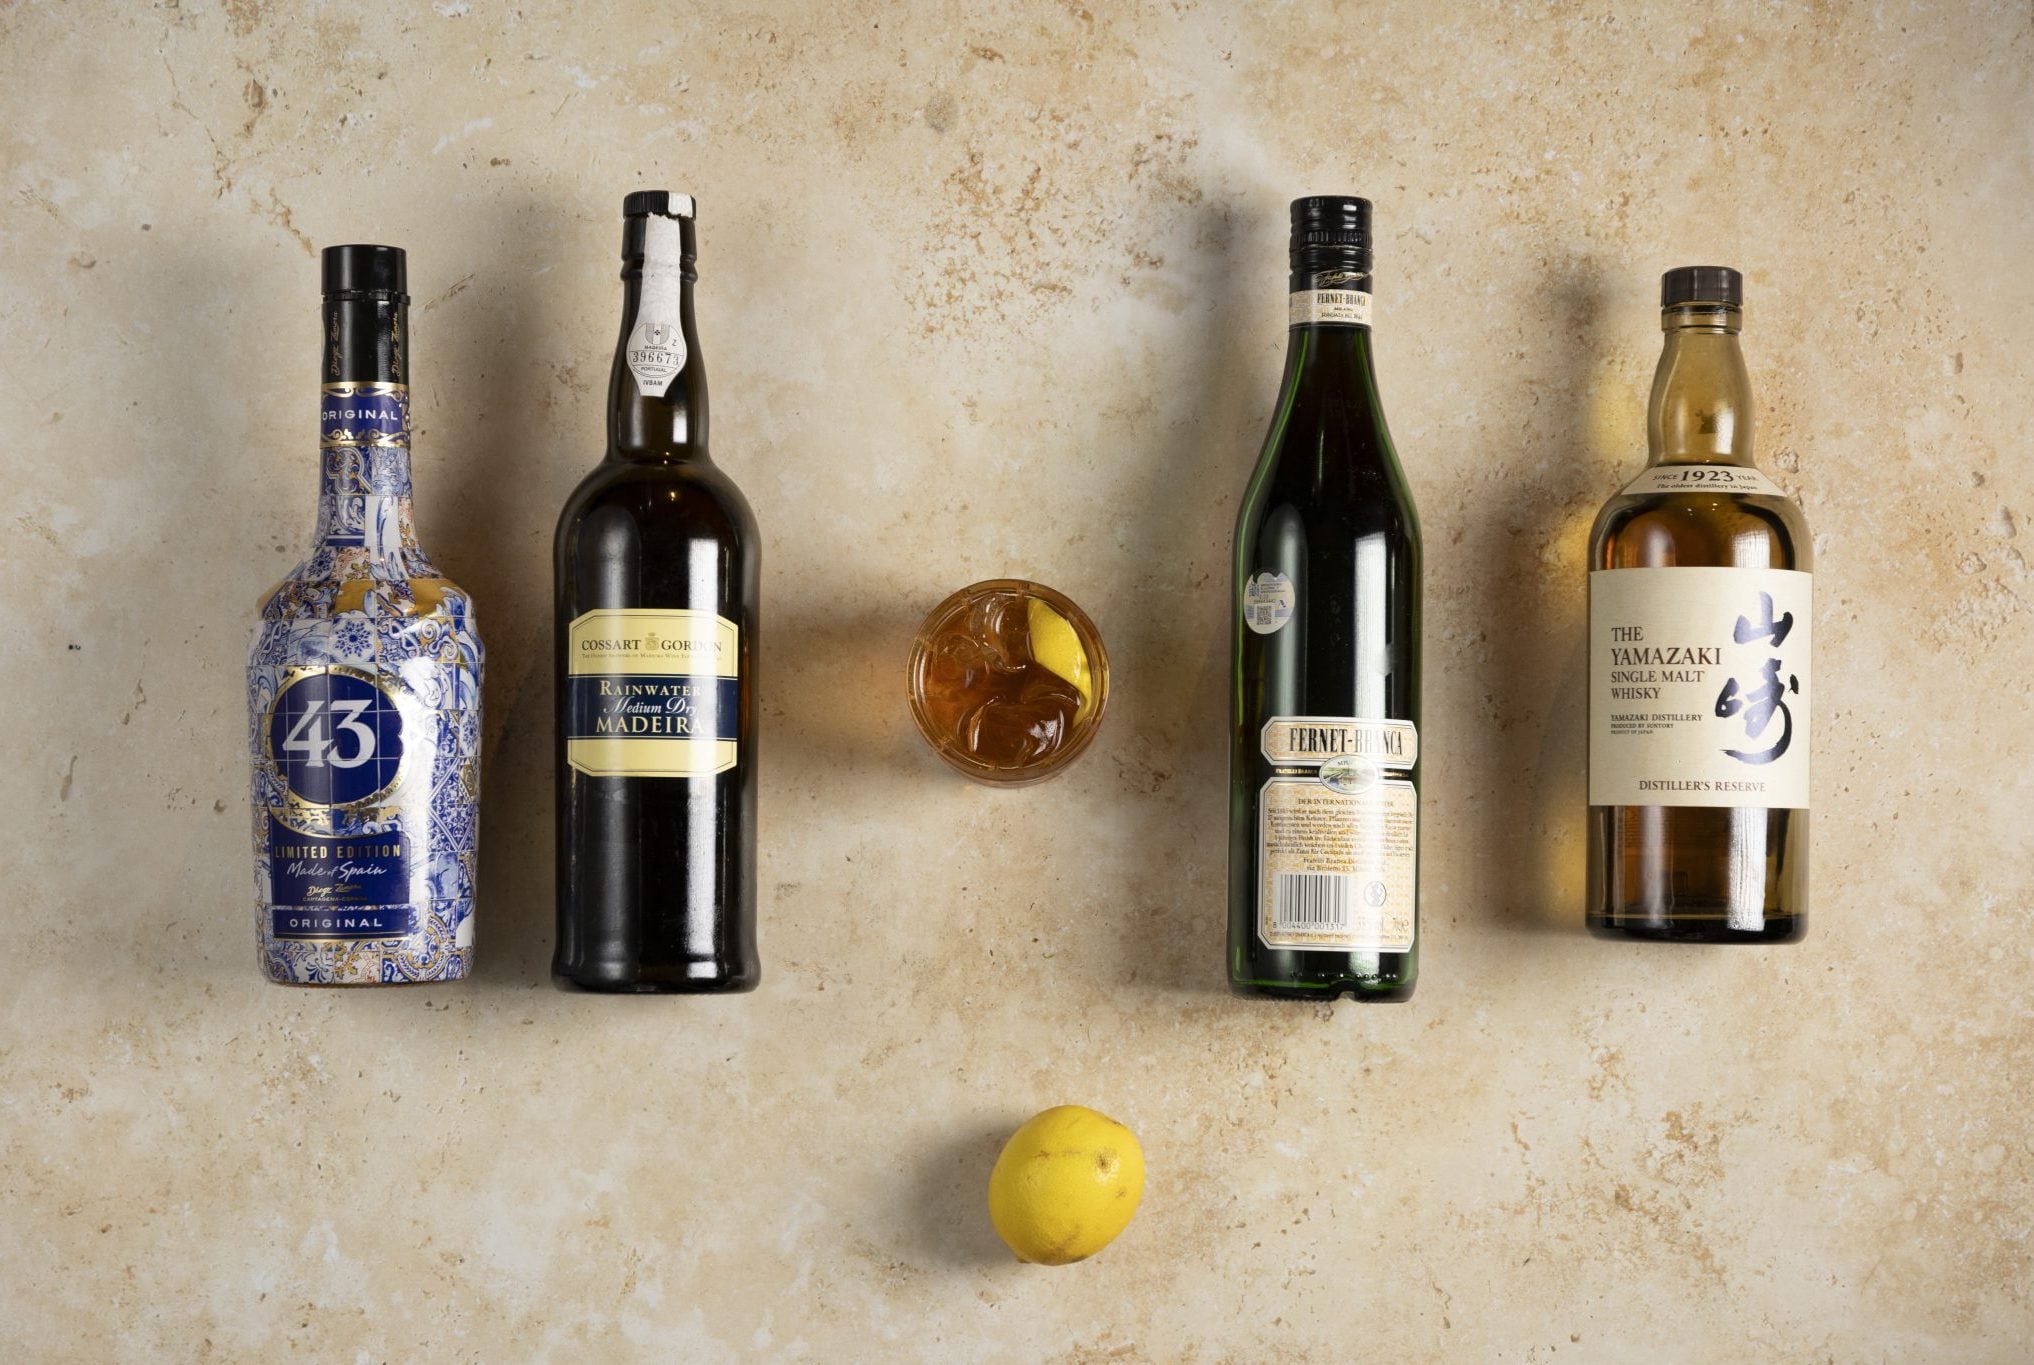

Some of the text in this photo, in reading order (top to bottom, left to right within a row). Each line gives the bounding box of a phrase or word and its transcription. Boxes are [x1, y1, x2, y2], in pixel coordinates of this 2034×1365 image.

[632, 351, 679, 366] 396673
[322, 407, 398, 422] ORIGINAL
[1653, 473, 1678, 481] SINCE
[1682, 470, 1734, 482] 1923
[1695, 482, 1728, 490] distillery
[1611, 626, 1644, 642] THE
[581, 639, 722, 652] COSSART GORDON
[1610, 647, 1722, 666] YAMAZAKI
[1610, 670, 1705, 683] SINGLE MALT
[599, 680, 702, 697] RAINWATER
[1610, 687, 1662, 701] WHISKY
[603, 696, 697, 716] Medium Dry
[596, 715, 704, 734] MADEIRA
[1610, 714, 1704, 722] YAMAZAKI DISTILLERY
[282, 699, 376, 768] 43
[1639, 780, 1766, 793] DISTILLER'S RESERVE
[275, 844, 401, 859] LIMITED EDITION
[287, 860, 388, 882] Made of Spain
[289, 918, 383, 928] ORIGINAL
